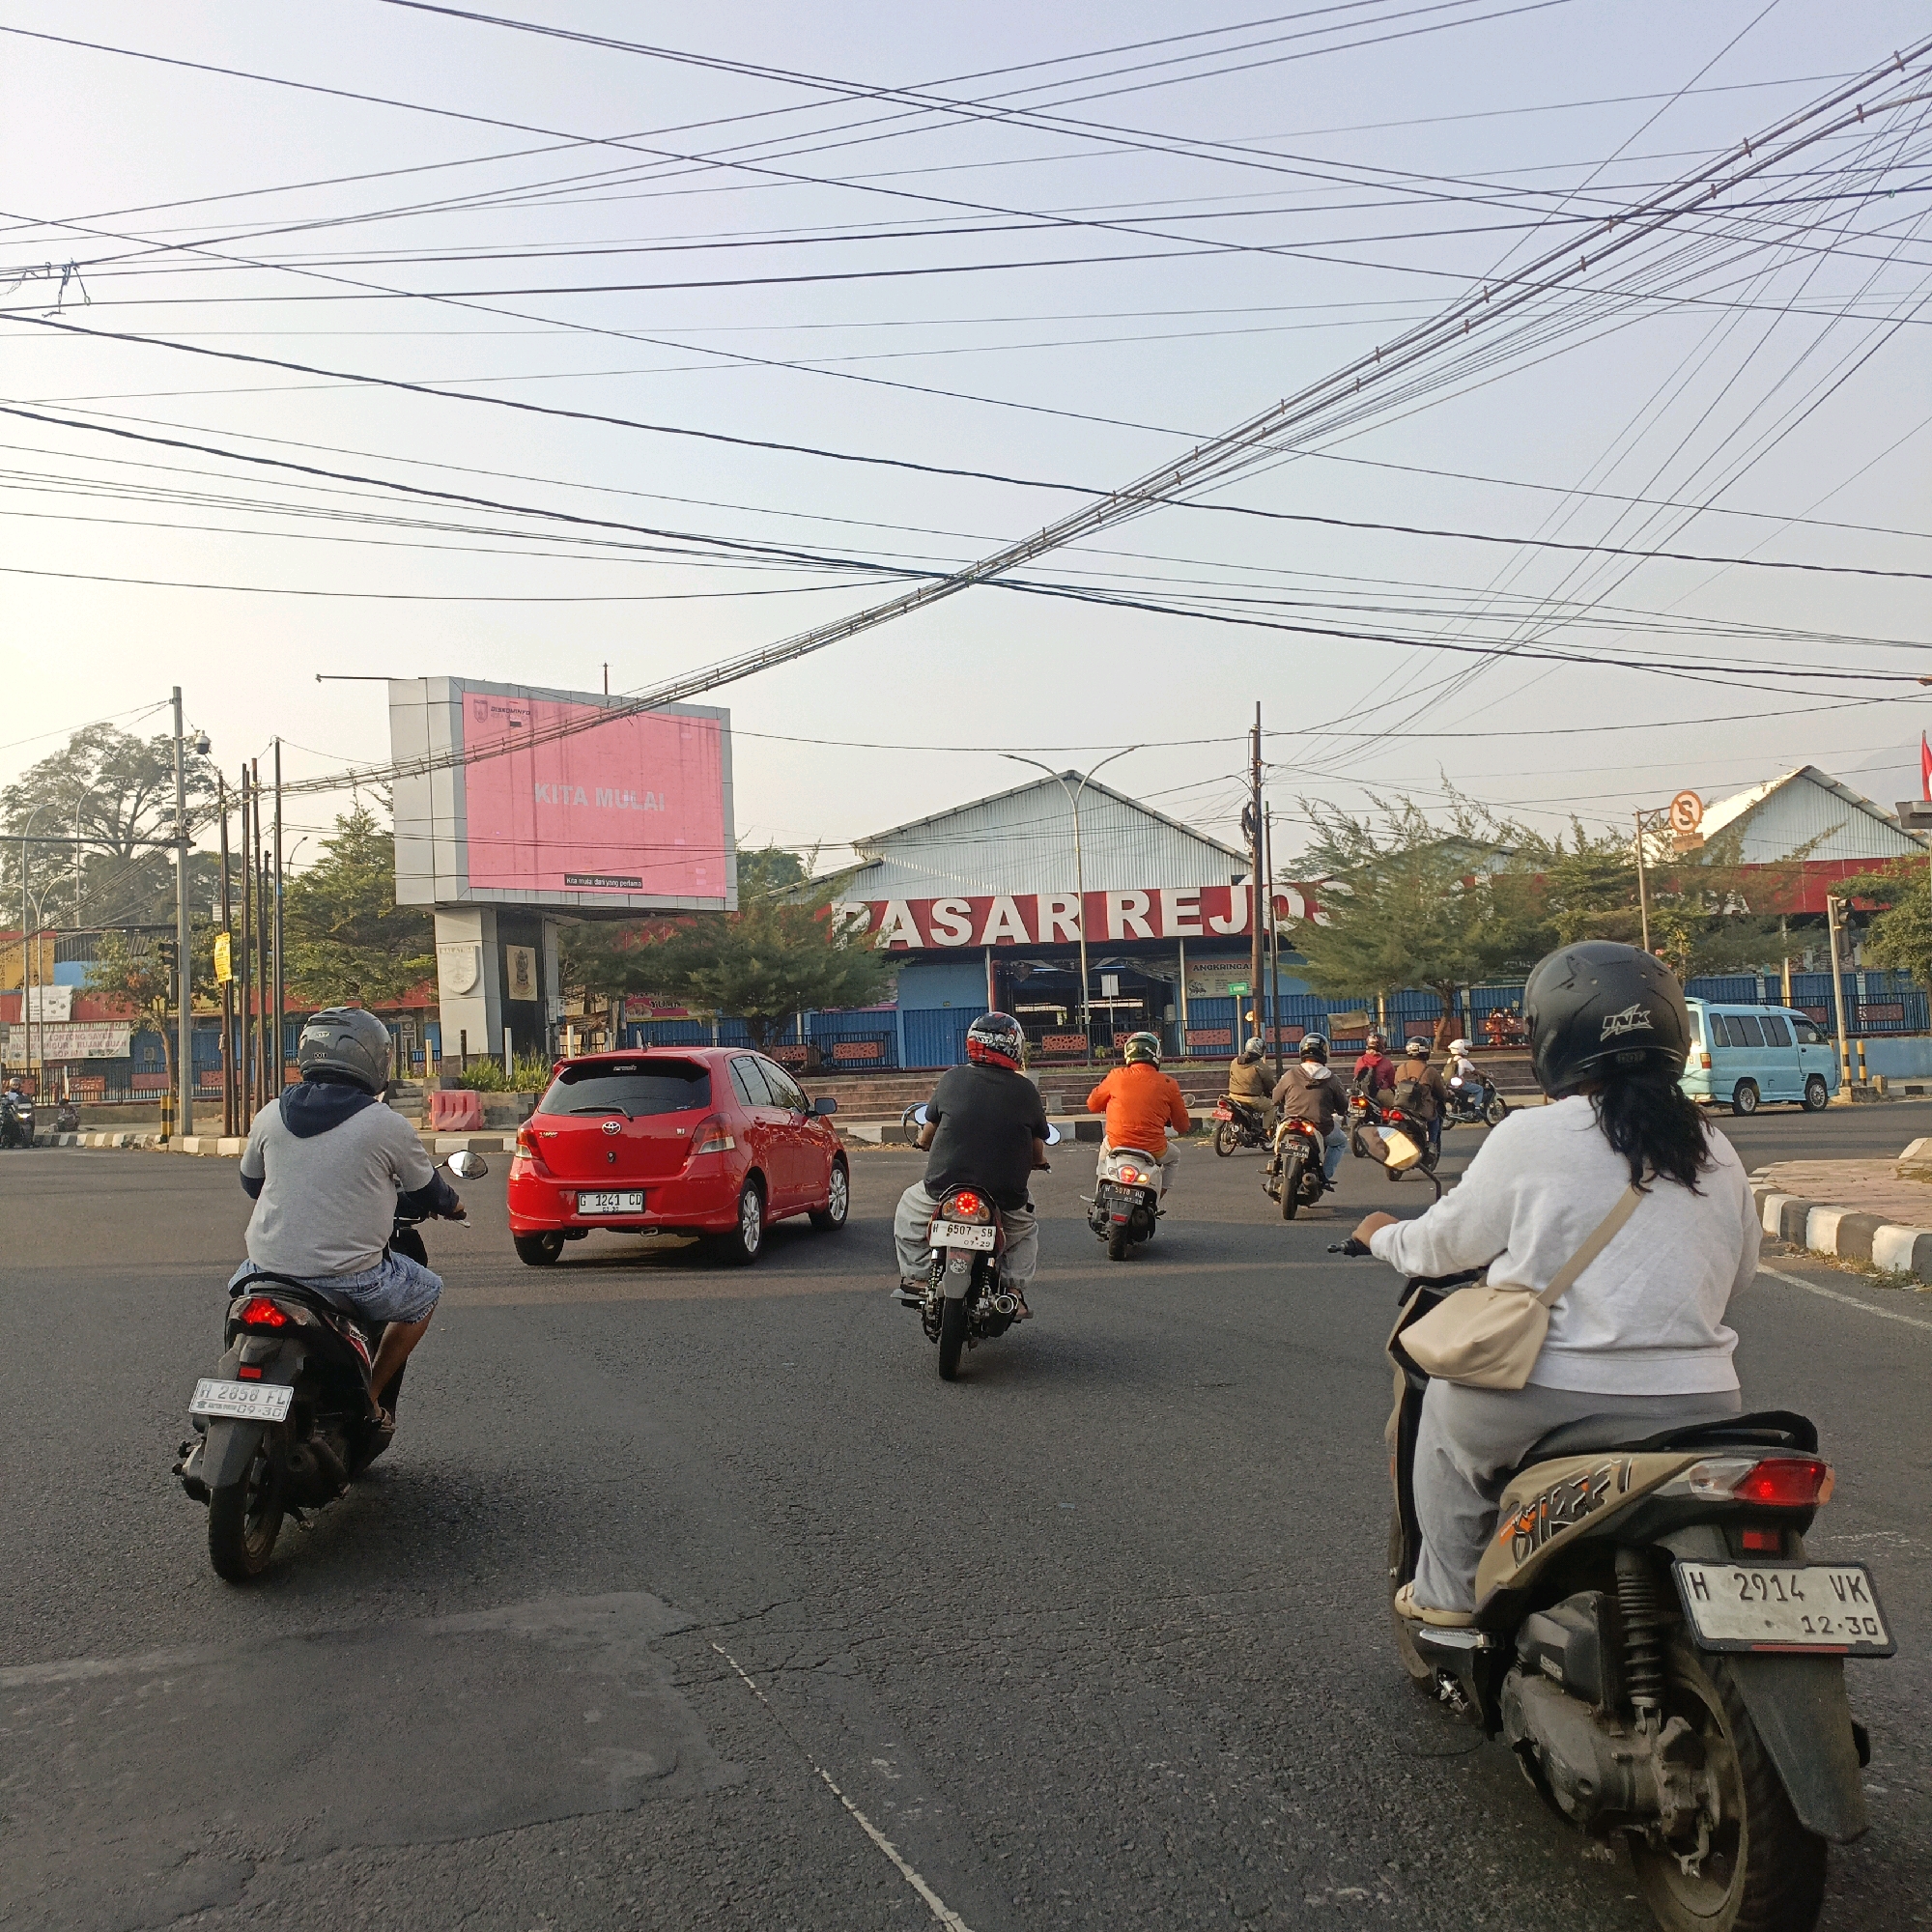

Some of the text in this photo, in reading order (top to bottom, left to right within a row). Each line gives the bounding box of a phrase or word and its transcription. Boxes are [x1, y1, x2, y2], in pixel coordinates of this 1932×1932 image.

[534, 782, 665, 811] KITA MULAI
[831, 894, 1081, 951] PASAR
[10, 1024, 38, 1034] WARNG
[41, 1023, 63, 1033] AKAN
[580, 1195, 586, 1207] G
[630, 1194, 642, 1206] CD
[933, 1223, 993, 1237] H 6507 SB
[200, 1382, 286, 1405] H 2858 FL
[1690, 1572, 1868, 1604] H 2914 VK
